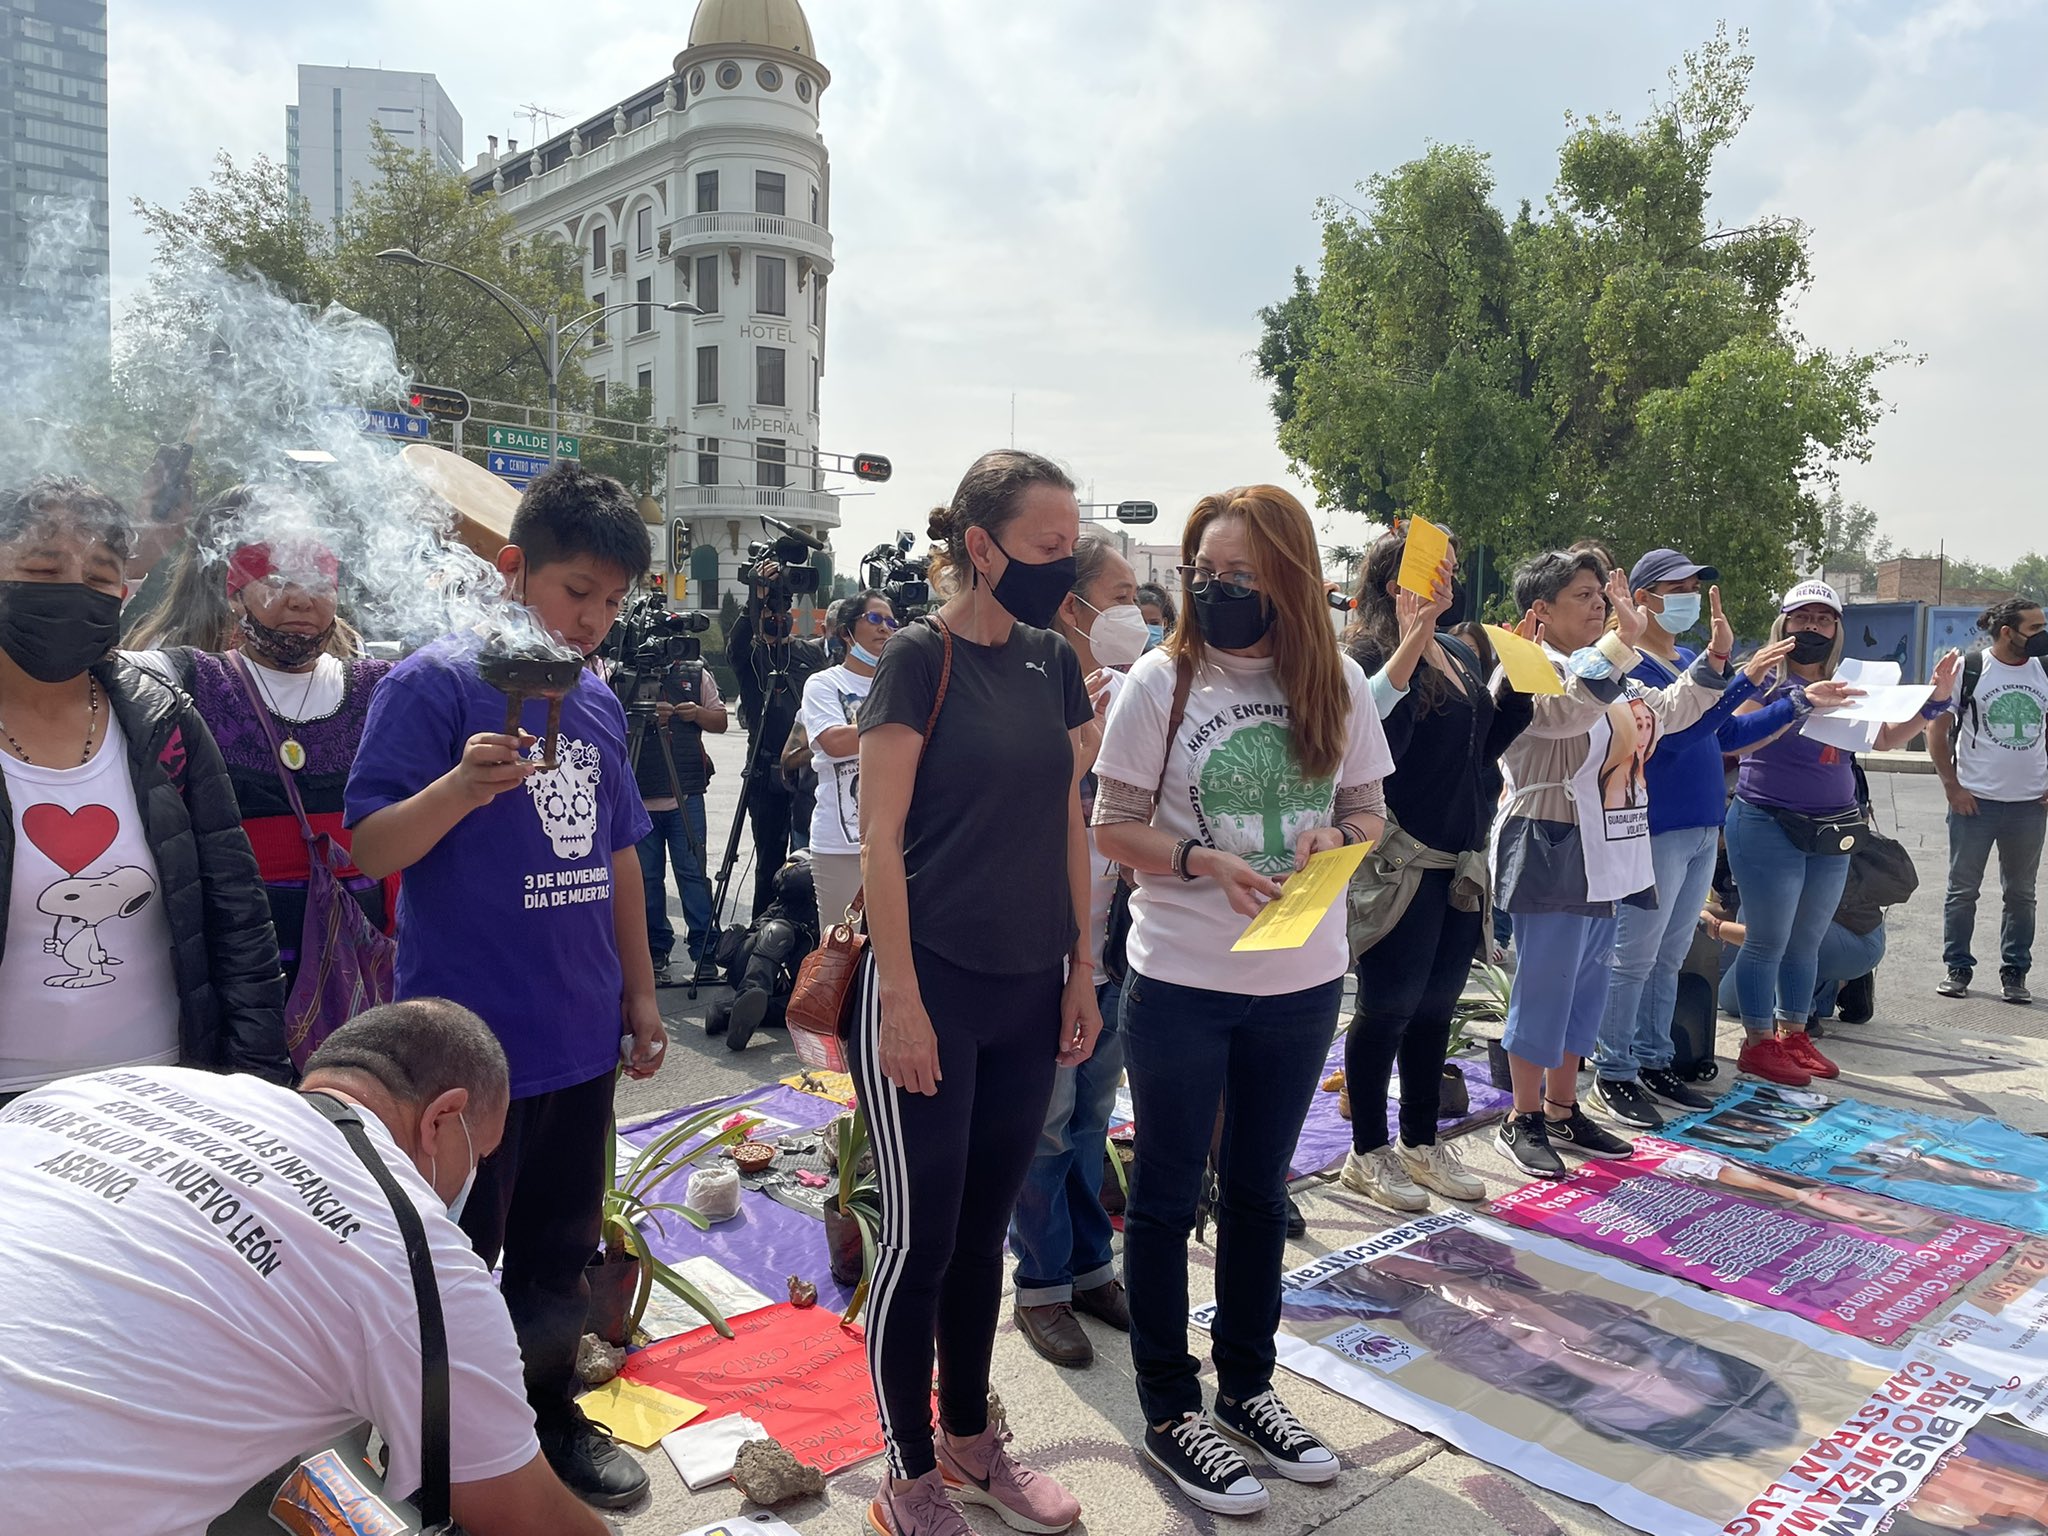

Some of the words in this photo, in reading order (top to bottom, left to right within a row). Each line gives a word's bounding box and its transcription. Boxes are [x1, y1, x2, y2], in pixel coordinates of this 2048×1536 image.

[740, 325, 797, 344] HOTEL
[732, 417, 804, 436] IMPERIAL
[507, 432, 573, 453] BALDEAS
[509, 459, 529, 473] CENTRO
[1796, 588, 1832, 600] RENATA
[1187, 710, 1232, 752] HASTA
[524, 875, 535, 889] 3
[537, 873, 555, 889] DE
[556, 867, 609, 887] NOVIEMBRE
[524, 890, 549, 909] DÍA
[551, 891, 567, 906] DE
[568, 884, 610, 904] MUERTAS
[94, 1101, 178, 1133] ESTADO
[165, 1127, 265, 1187] MEXICANO.
[126, 1080, 161, 1098] DE
[153, 1091, 254, 1137] VIOLENTAR
[238, 1130, 288, 1159] LAS
[271, 1156, 361, 1244] INFANCIAS,
[33, 1150, 140, 1204] ASESINO.
[38, 1111, 90, 1133] DE
[66, 1122, 147, 1155] SALUD
[132, 1147, 178, 1171] DE
[157, 1159, 242, 1225] NUEVO
[226, 1215, 282, 1278] LEÓN
[1892, 1371, 1971, 1433] PABLO
[1948, 1383, 1998, 1414] TE
[808, 1444, 862, 1470] CON
